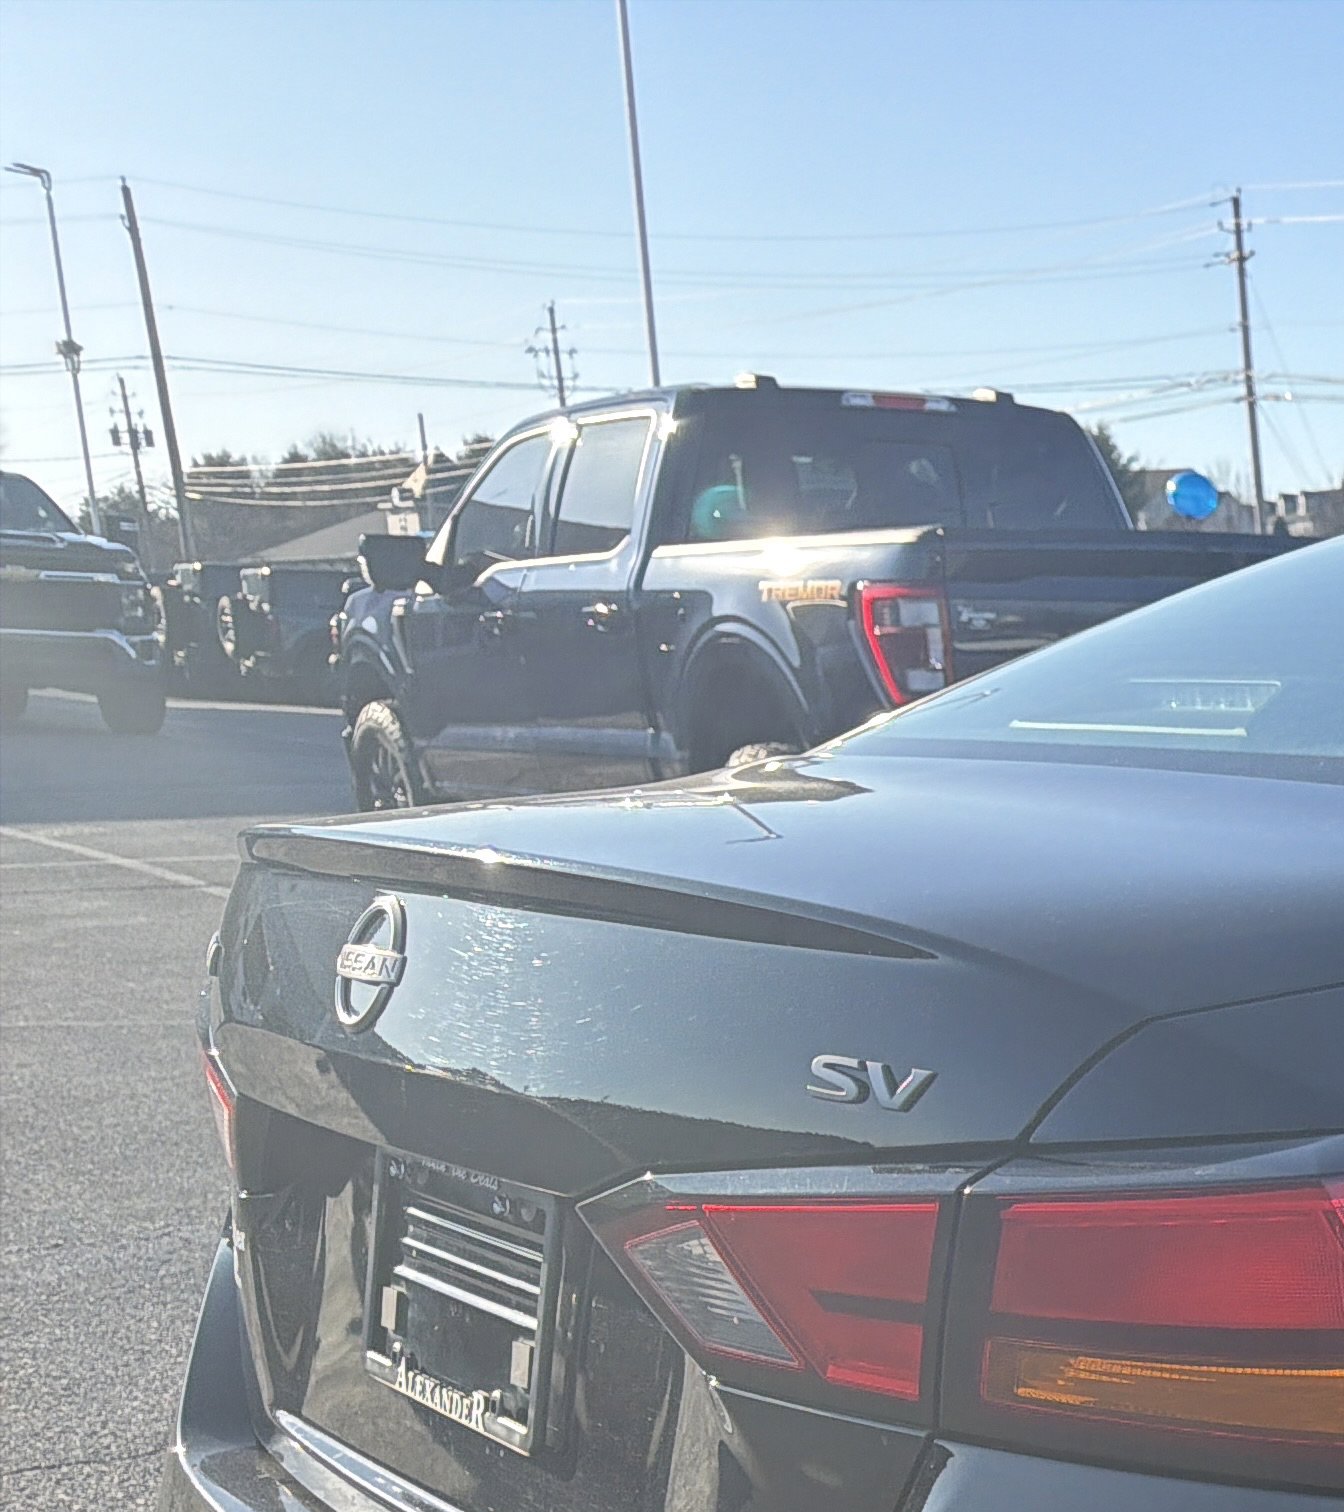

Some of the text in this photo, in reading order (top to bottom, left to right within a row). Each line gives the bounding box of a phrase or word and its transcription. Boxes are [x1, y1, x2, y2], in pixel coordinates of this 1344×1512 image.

[758, 579, 842, 602] TREMOR
[339, 949, 399, 979] ISSAN
[806, 1054, 938, 1112] SV
